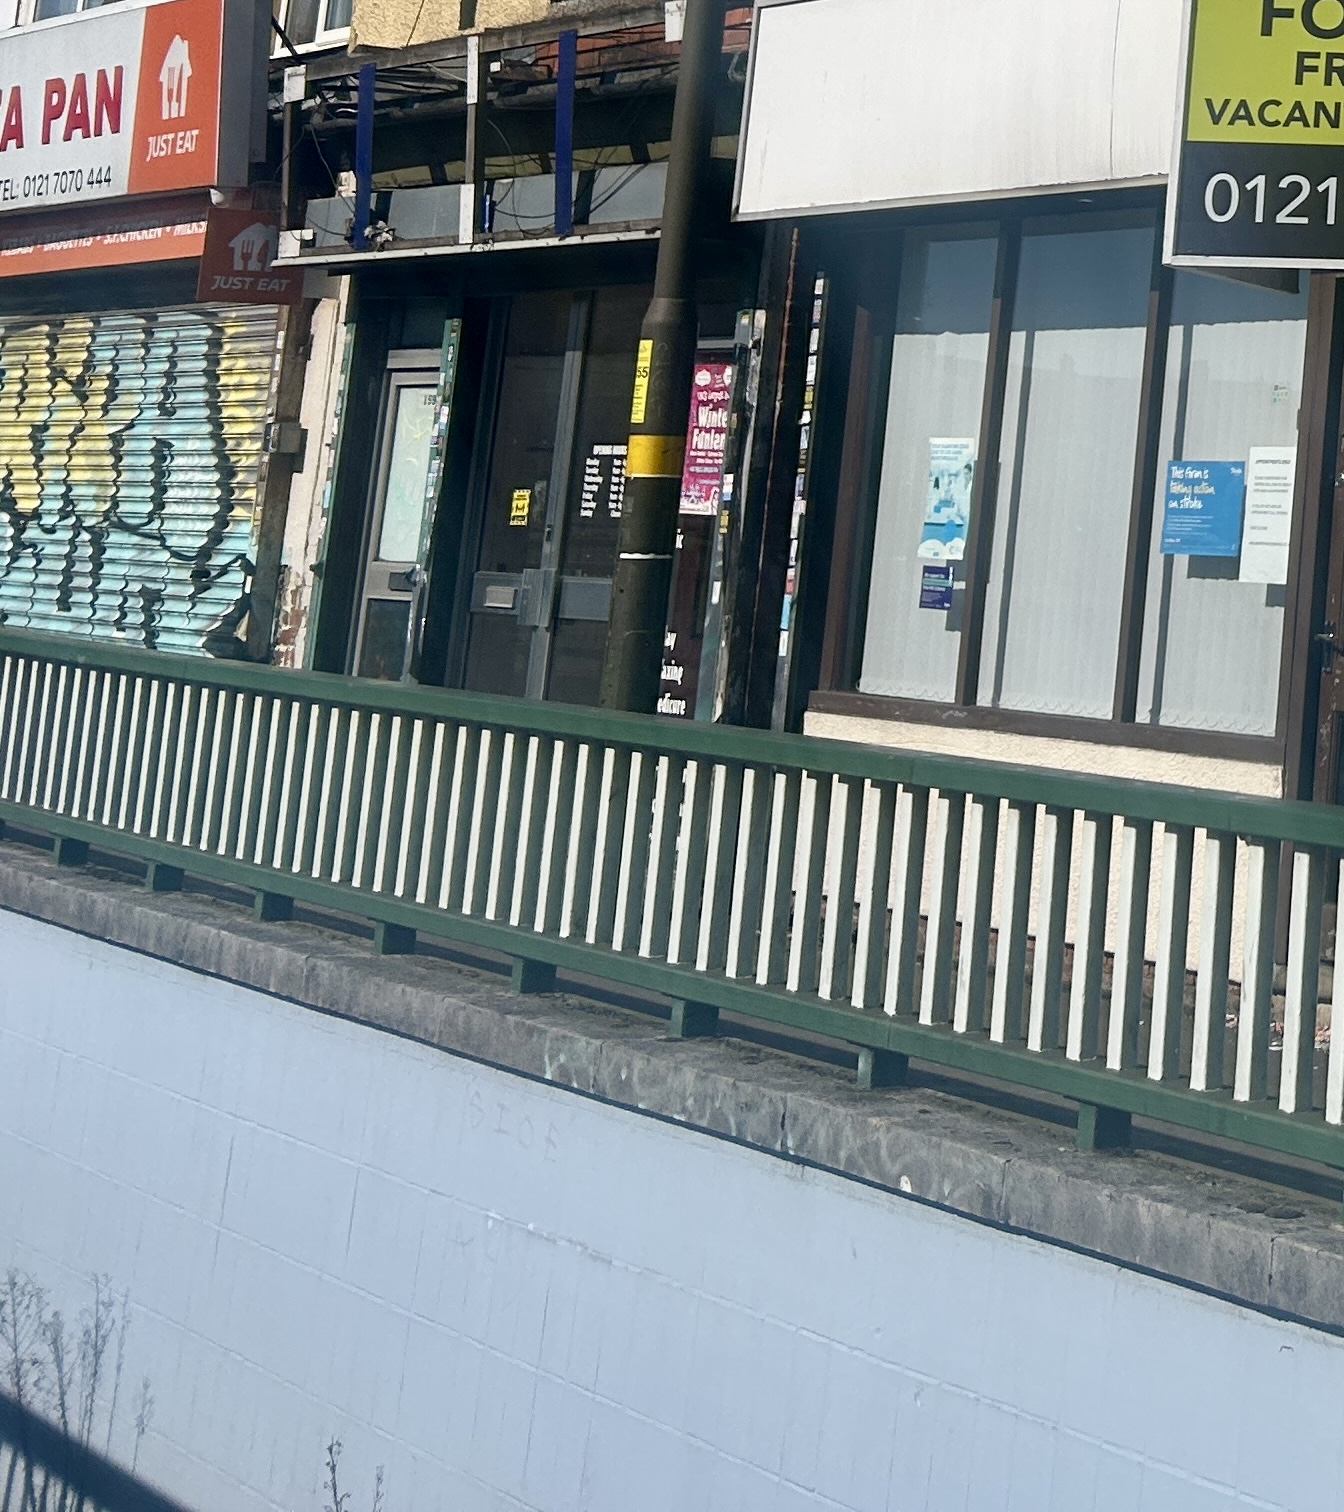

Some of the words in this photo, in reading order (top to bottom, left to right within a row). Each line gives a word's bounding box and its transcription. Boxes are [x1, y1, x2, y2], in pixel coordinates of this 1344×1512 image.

[41, 65, 124, 145] PAN
[146, 132, 175, 162] JUST
[176, 129, 199, 153] EAT
[23, 173, 50, 198] 0121
[53, 168, 83, 194] 7070
[87, 165, 112, 187] 444
[1204, 172, 1338, 226] 0121
[210, 275, 253, 291] JUST
[257, 278, 291, 292] EAT
[698, 403, 728, 428] Winte
[692, 428, 725, 450] Funlan
[1171, 466, 1185, 479] This
[1169, 480, 1192, 495] taking
[1168, 499, 1178, 509] on
[1179, 494, 1203, 509] stroke
